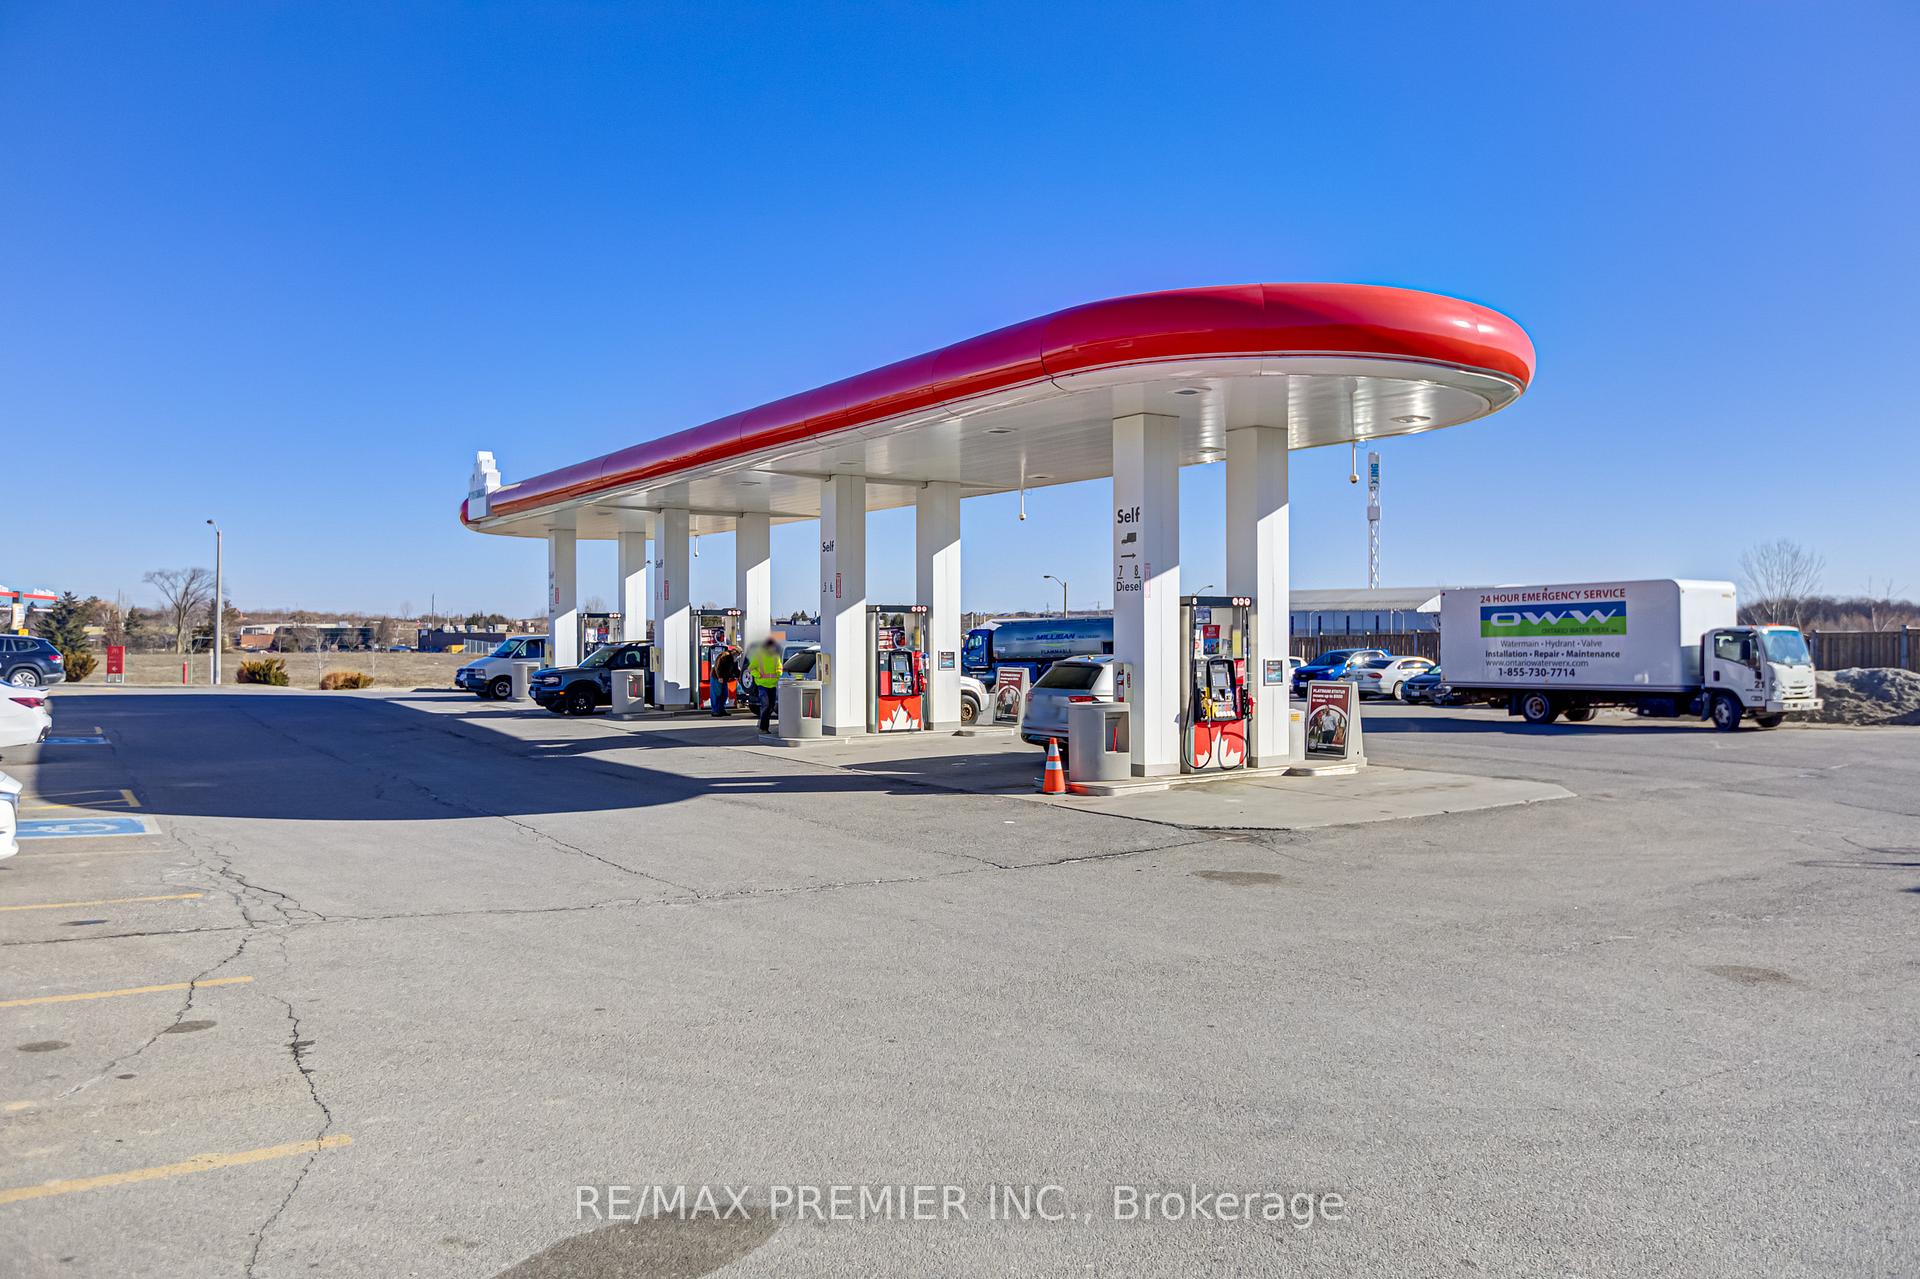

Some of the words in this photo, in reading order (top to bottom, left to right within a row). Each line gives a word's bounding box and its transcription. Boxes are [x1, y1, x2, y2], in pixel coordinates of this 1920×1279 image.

[1117, 506, 1140, 524] Self
[822, 540, 835, 552] Self
[1118, 565, 1123, 576] 7
[1134, 564, 1139, 576] 8
[1116, 580, 1142, 592] Diesel
[1480, 595, 1491, 604] 24
[1493, 593, 1520, 603] HOUR
[1521, 590, 1582, 602] EMERGENCY
[1583, 588, 1626, 600] SERVICE
[1490, 608, 1617, 627] OWW
[1500, 640, 1540, 648] Watermain
[1545, 640, 1576, 650] Hydrant
[1581, 640, 1603, 648] Valve
[1485, 650, 1528, 658] Installation
[1534, 650, 1560, 659] Repair
[1566, 650, 1621, 658] Maintenance
[1485, 659, 1589, 668] www.ontariowaterwerx.com
[1498, 668, 1576, 677] 1-855-730-7714
[1754, 680, 1765, 689] 21
